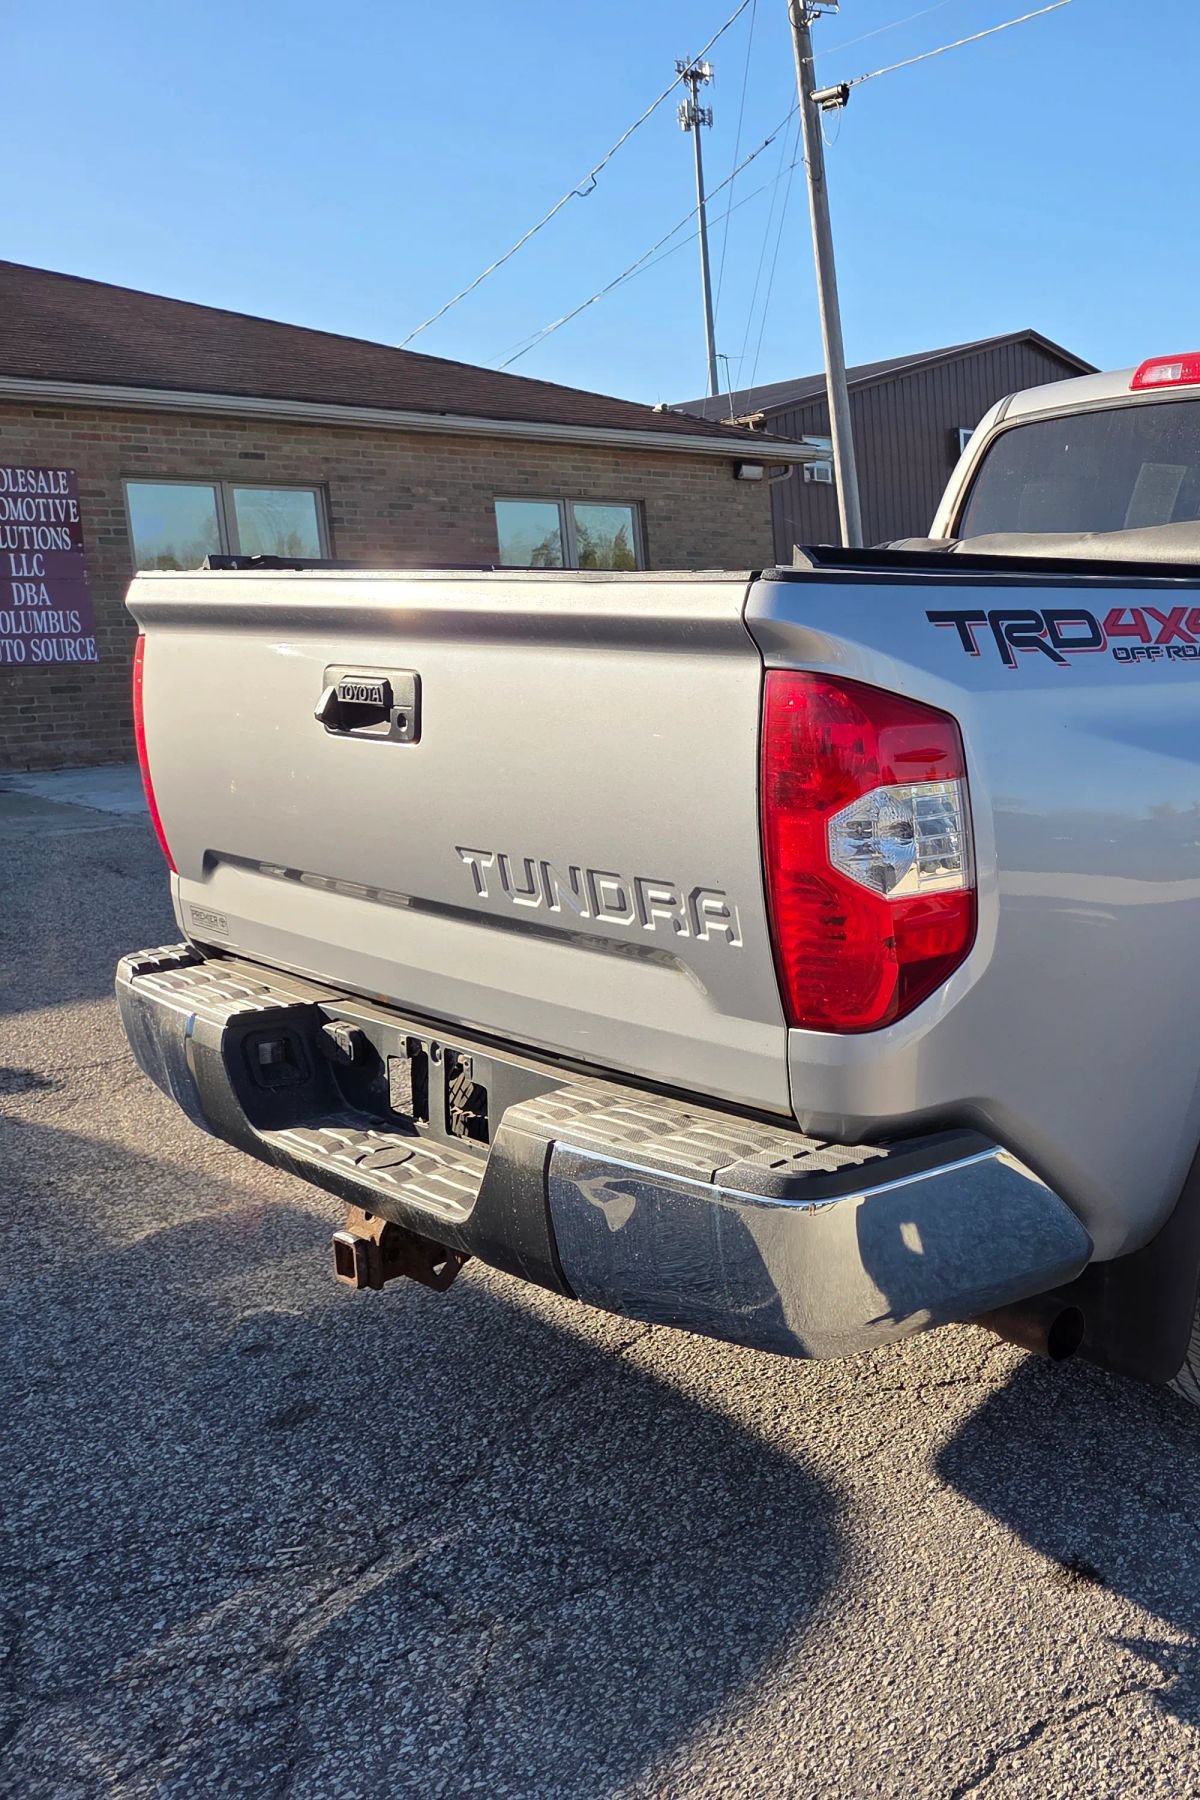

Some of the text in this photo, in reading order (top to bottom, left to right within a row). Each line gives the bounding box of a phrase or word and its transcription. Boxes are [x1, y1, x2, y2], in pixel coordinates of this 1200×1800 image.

[9, 553, 46, 577] LLC
[11, 582, 52, 606] DBA
[0, 637, 98, 662] TO SOURCE
[925, 609, 1108, 669] TRD
[1112, 646, 1162, 663] OFF
[339, 684, 383, 703] TOYOTA
[455, 846, 743, 947] TUNDRA
